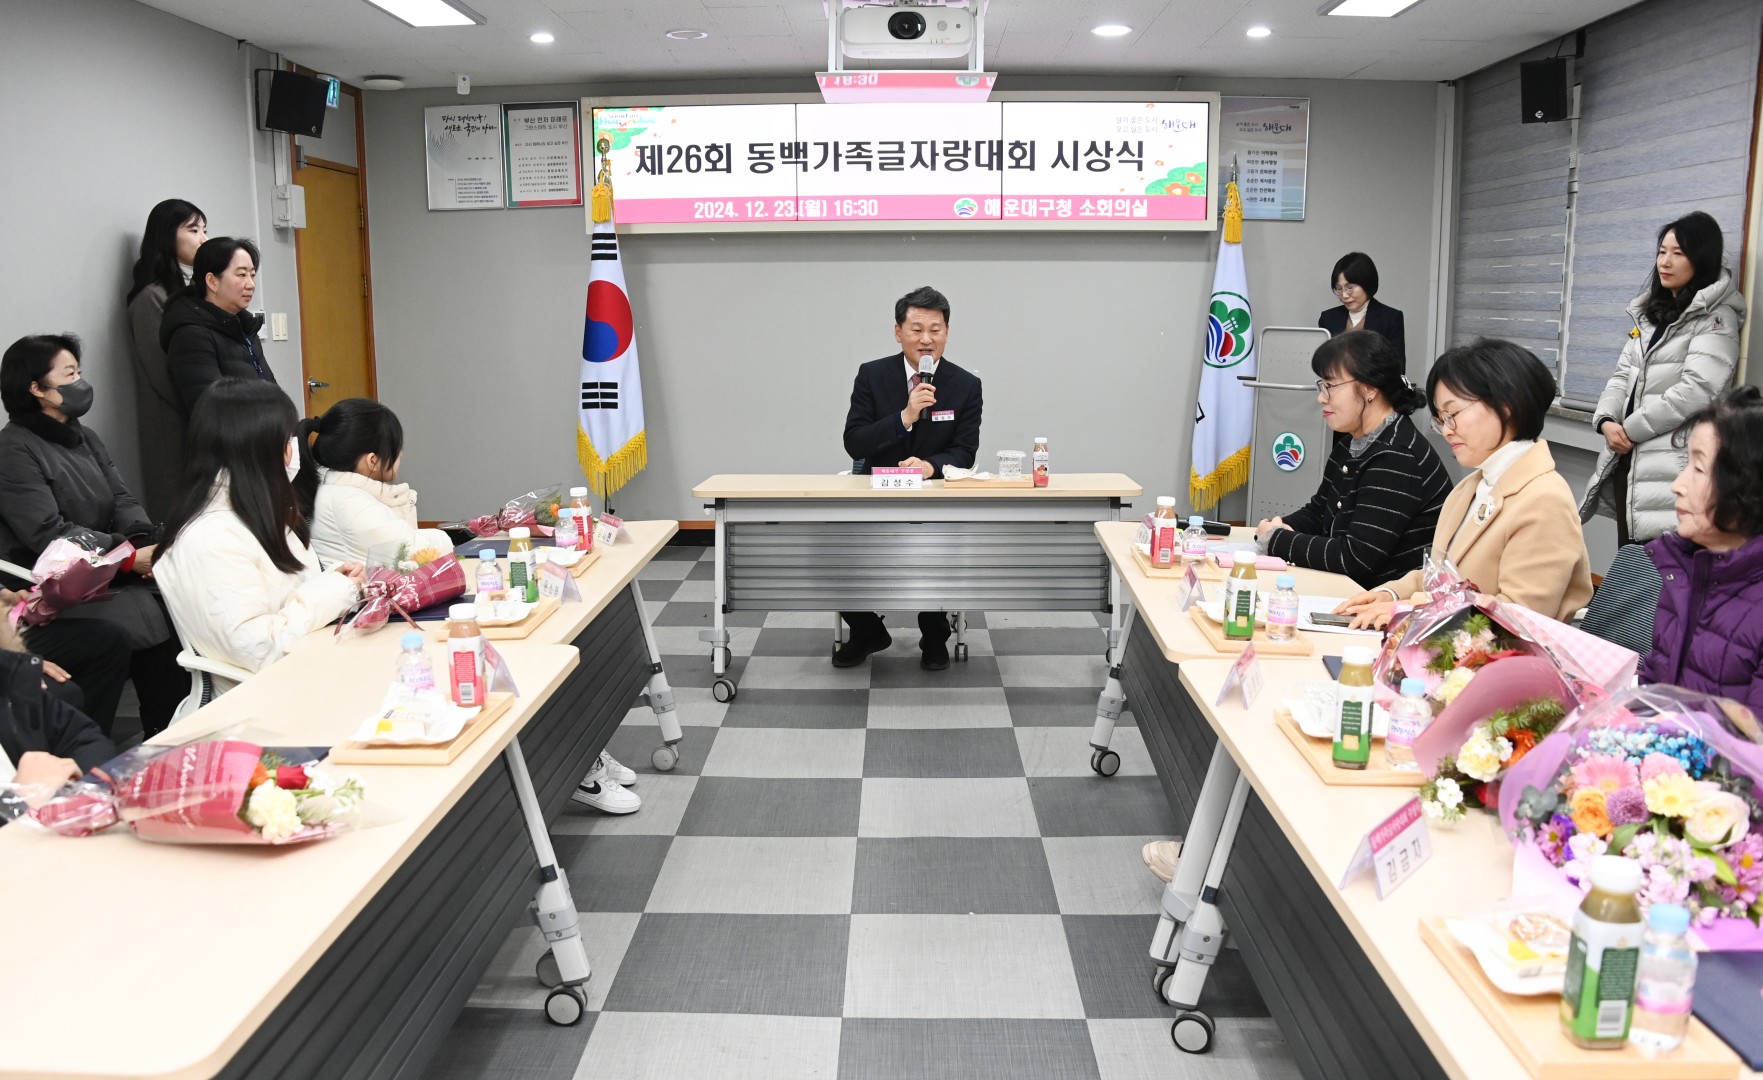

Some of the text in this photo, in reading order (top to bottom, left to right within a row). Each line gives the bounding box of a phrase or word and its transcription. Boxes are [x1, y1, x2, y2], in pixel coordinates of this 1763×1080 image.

[1145, 116, 1157, 124] 도시
[635, 140, 1144, 175] 제26회 동백가족글자랑대회 시상식
[694, 201, 739, 219] 2024.
[745, 200, 769, 218] 12.
[833, 199, 878, 217] 16:30
[984, 199, 1148, 217] 해운대구청 소회의실
